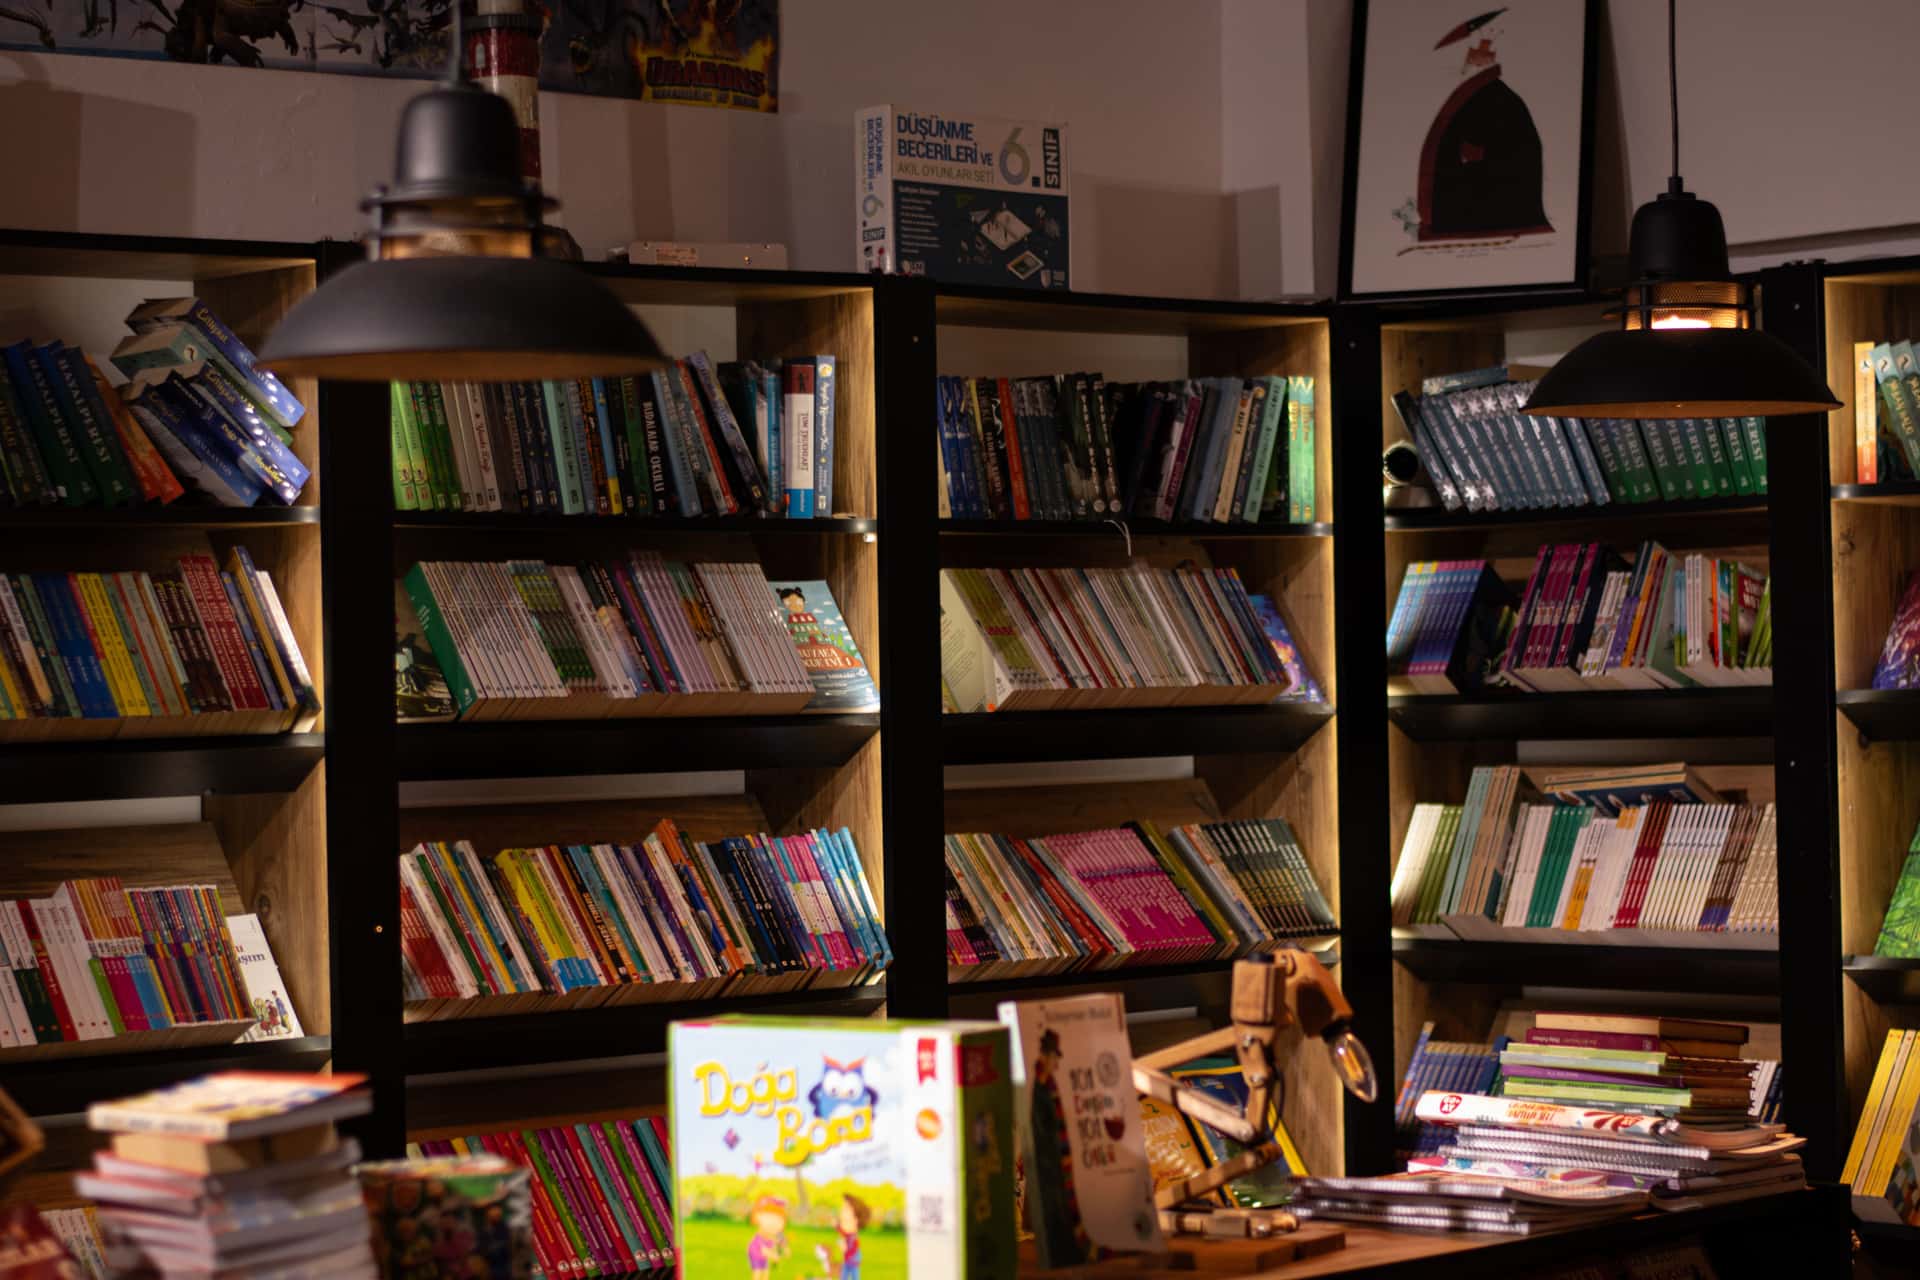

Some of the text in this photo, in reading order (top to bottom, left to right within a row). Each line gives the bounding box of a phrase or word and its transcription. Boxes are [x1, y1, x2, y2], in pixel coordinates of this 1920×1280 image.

[897, 115, 974, 141] DÜŞÜNME
[897, 139, 993, 167] BECERİLERİ VE
[1043, 128, 1060, 188] SINIF
[922, 165, 972, 182] OYUNLARI
[973, 168, 994, 185] SETİ
[694, 1061, 798, 1118] Doğa
